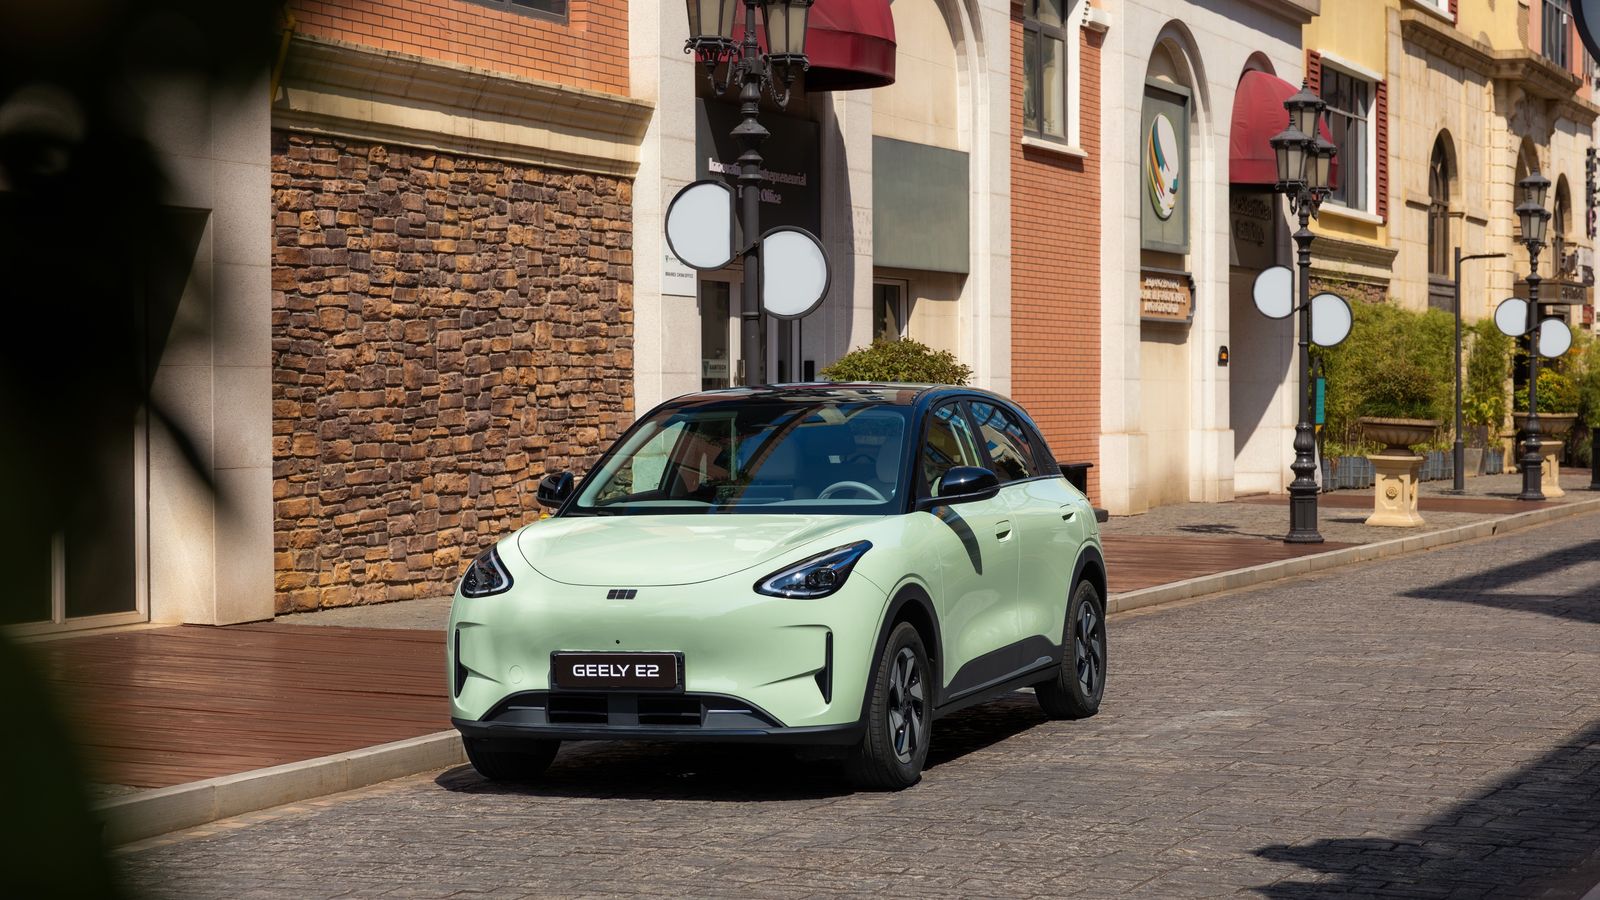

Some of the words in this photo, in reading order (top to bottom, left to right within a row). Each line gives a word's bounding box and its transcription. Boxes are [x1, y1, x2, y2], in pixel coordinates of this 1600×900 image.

[761, 188, 782, 204] Office
[572, 664, 630, 677] GEELY
[635, 664, 660, 677] E2
